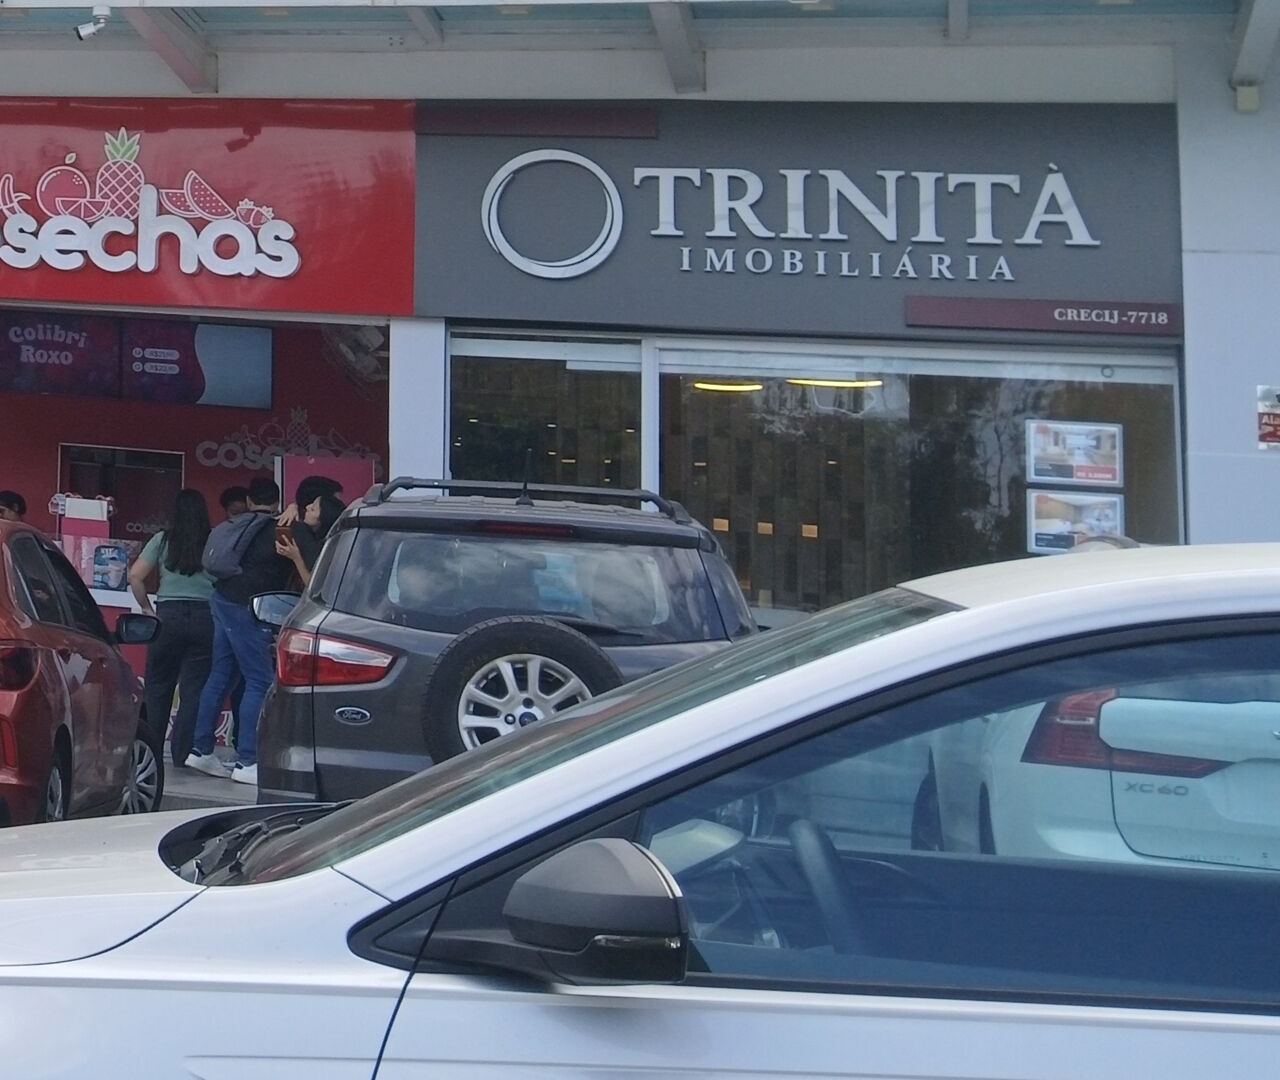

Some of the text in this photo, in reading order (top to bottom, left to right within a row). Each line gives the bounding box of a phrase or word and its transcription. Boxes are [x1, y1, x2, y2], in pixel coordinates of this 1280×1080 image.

[679, 246, 1016, 282] IMOBILIÁRIA
[8, 324, 88, 348] Colibri
[19, 344, 74, 366] Roxo
